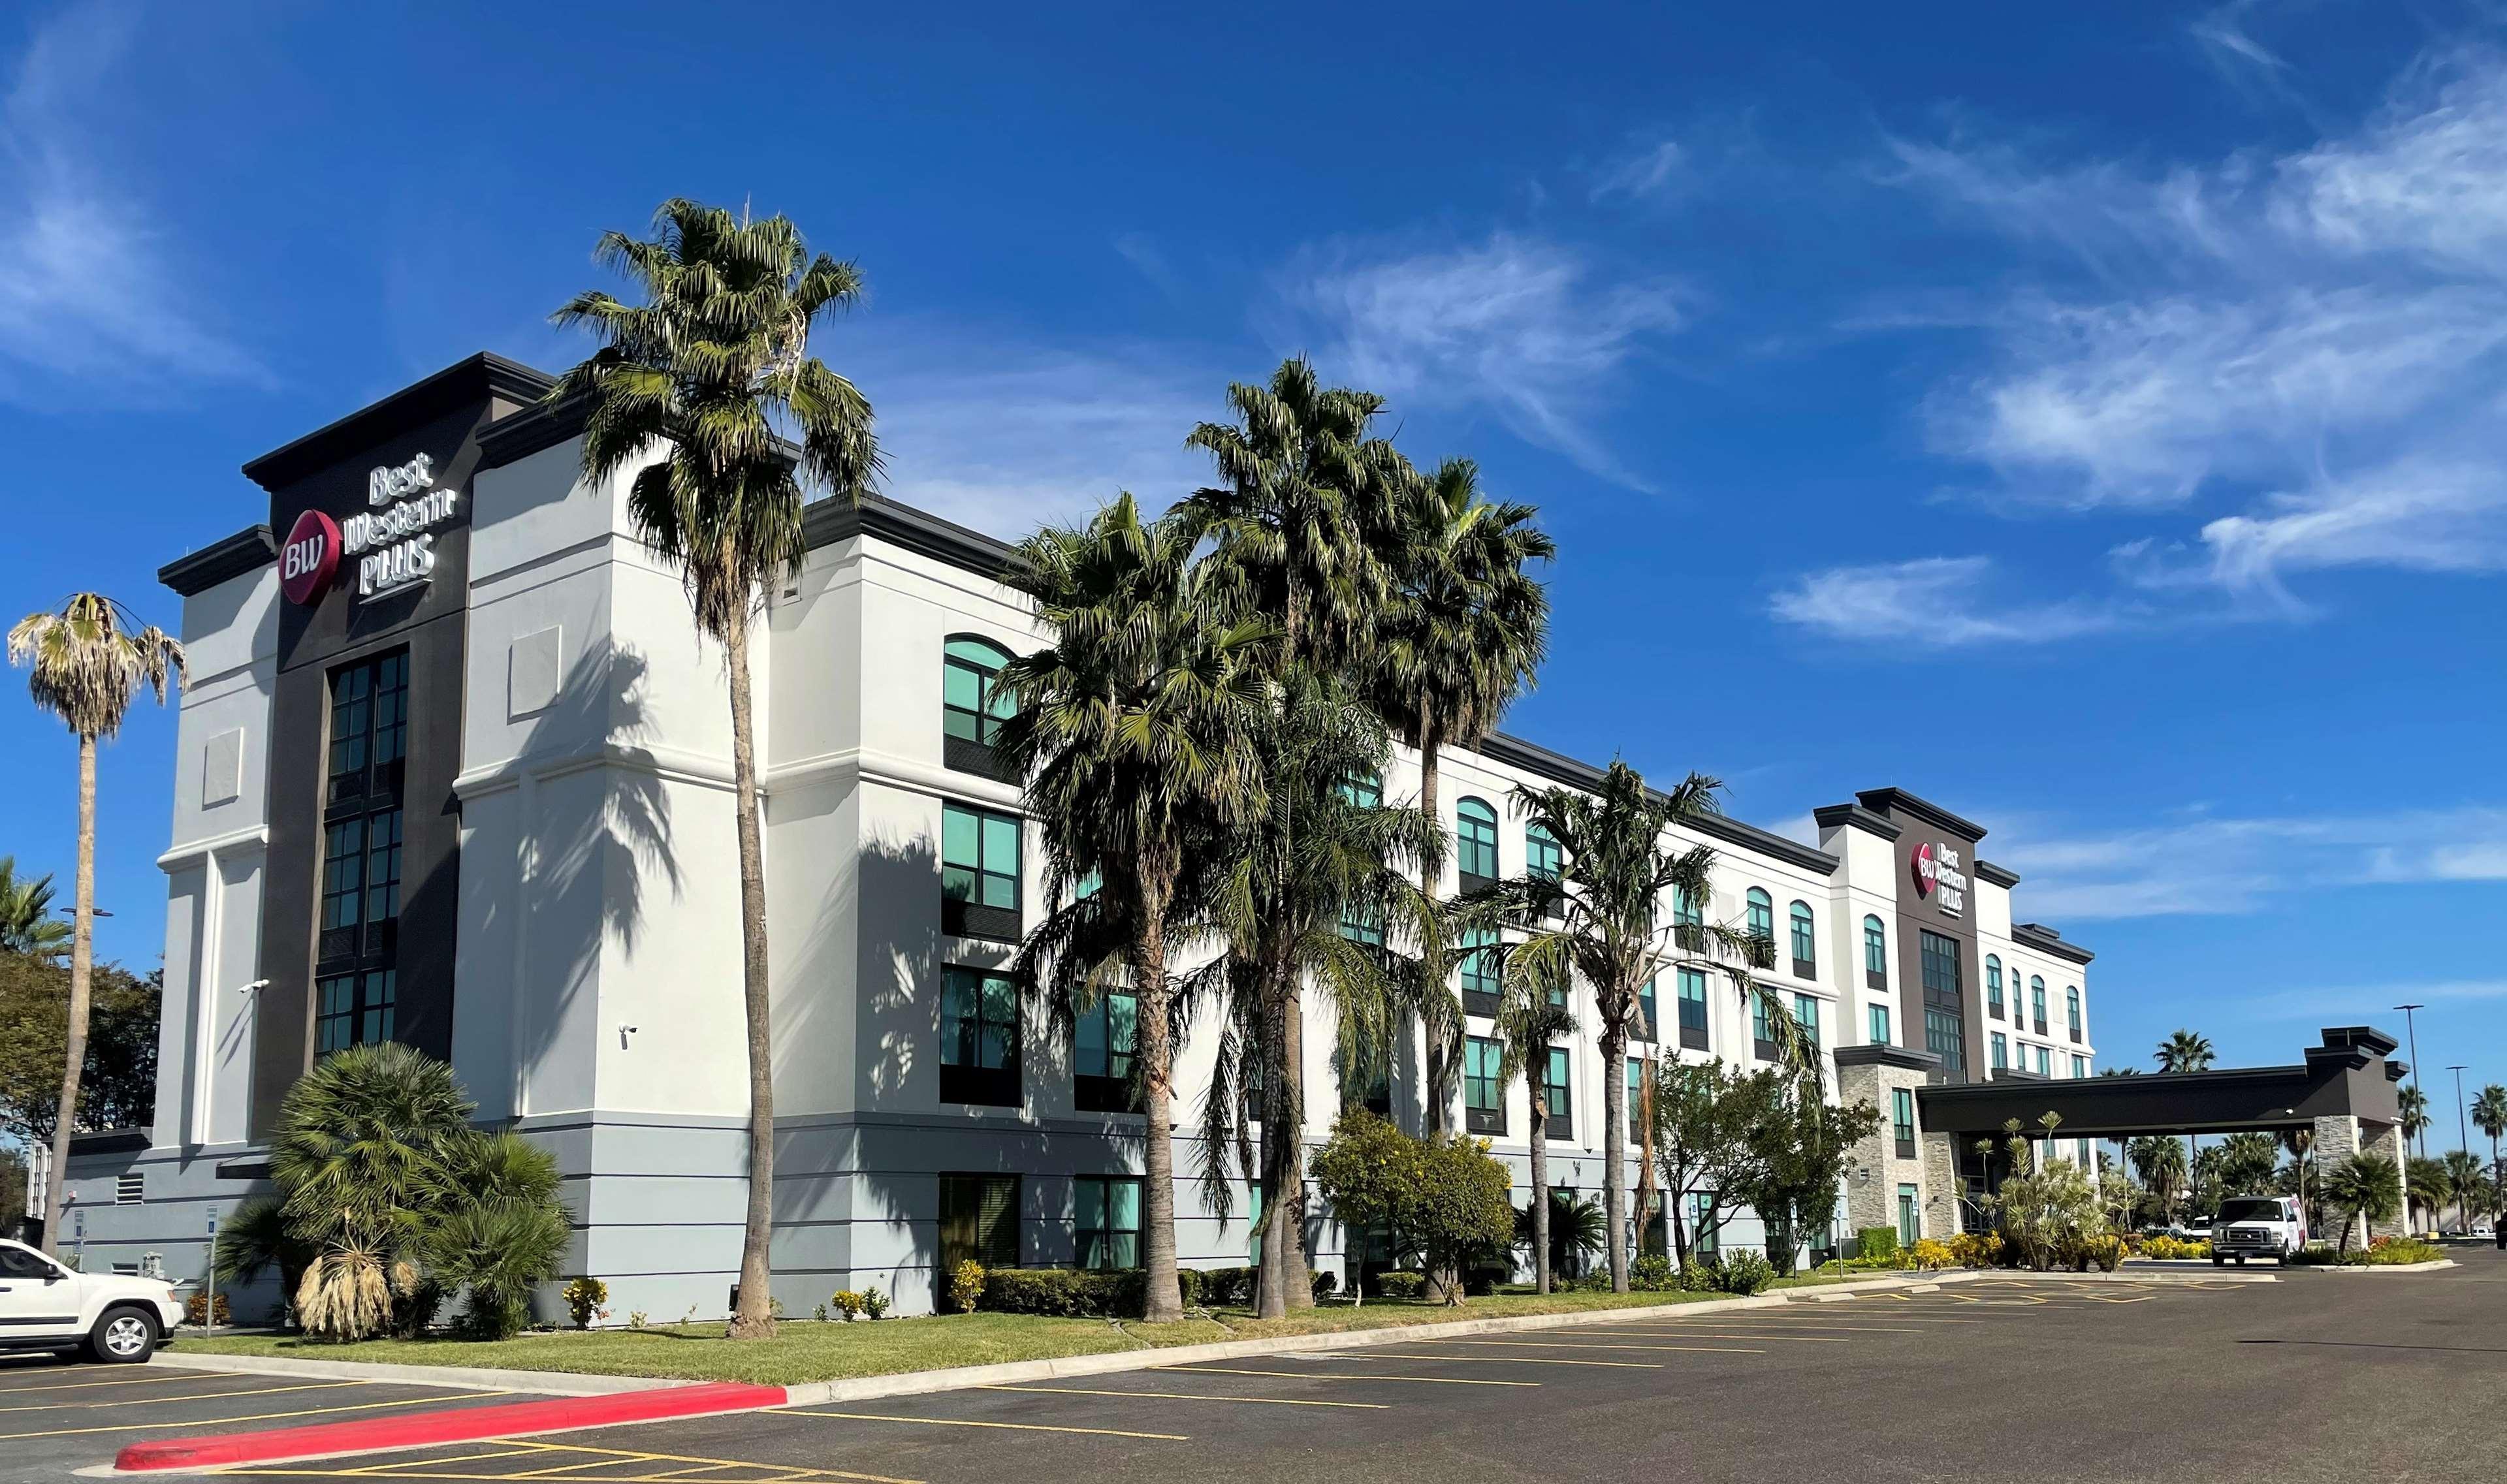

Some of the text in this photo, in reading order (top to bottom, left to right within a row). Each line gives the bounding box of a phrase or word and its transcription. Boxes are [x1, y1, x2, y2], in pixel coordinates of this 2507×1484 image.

[369, 452, 434, 506] Best
[343, 488, 456, 555] Western
[285, 534, 323, 580] BW
[359, 533, 435, 595] PLUS
[1921, 857, 1934, 879] BW
[1938, 842, 1959, 868] Best
[1934, 860, 1967, 891] Western
[1938, 885, 1962, 911] PLUS
